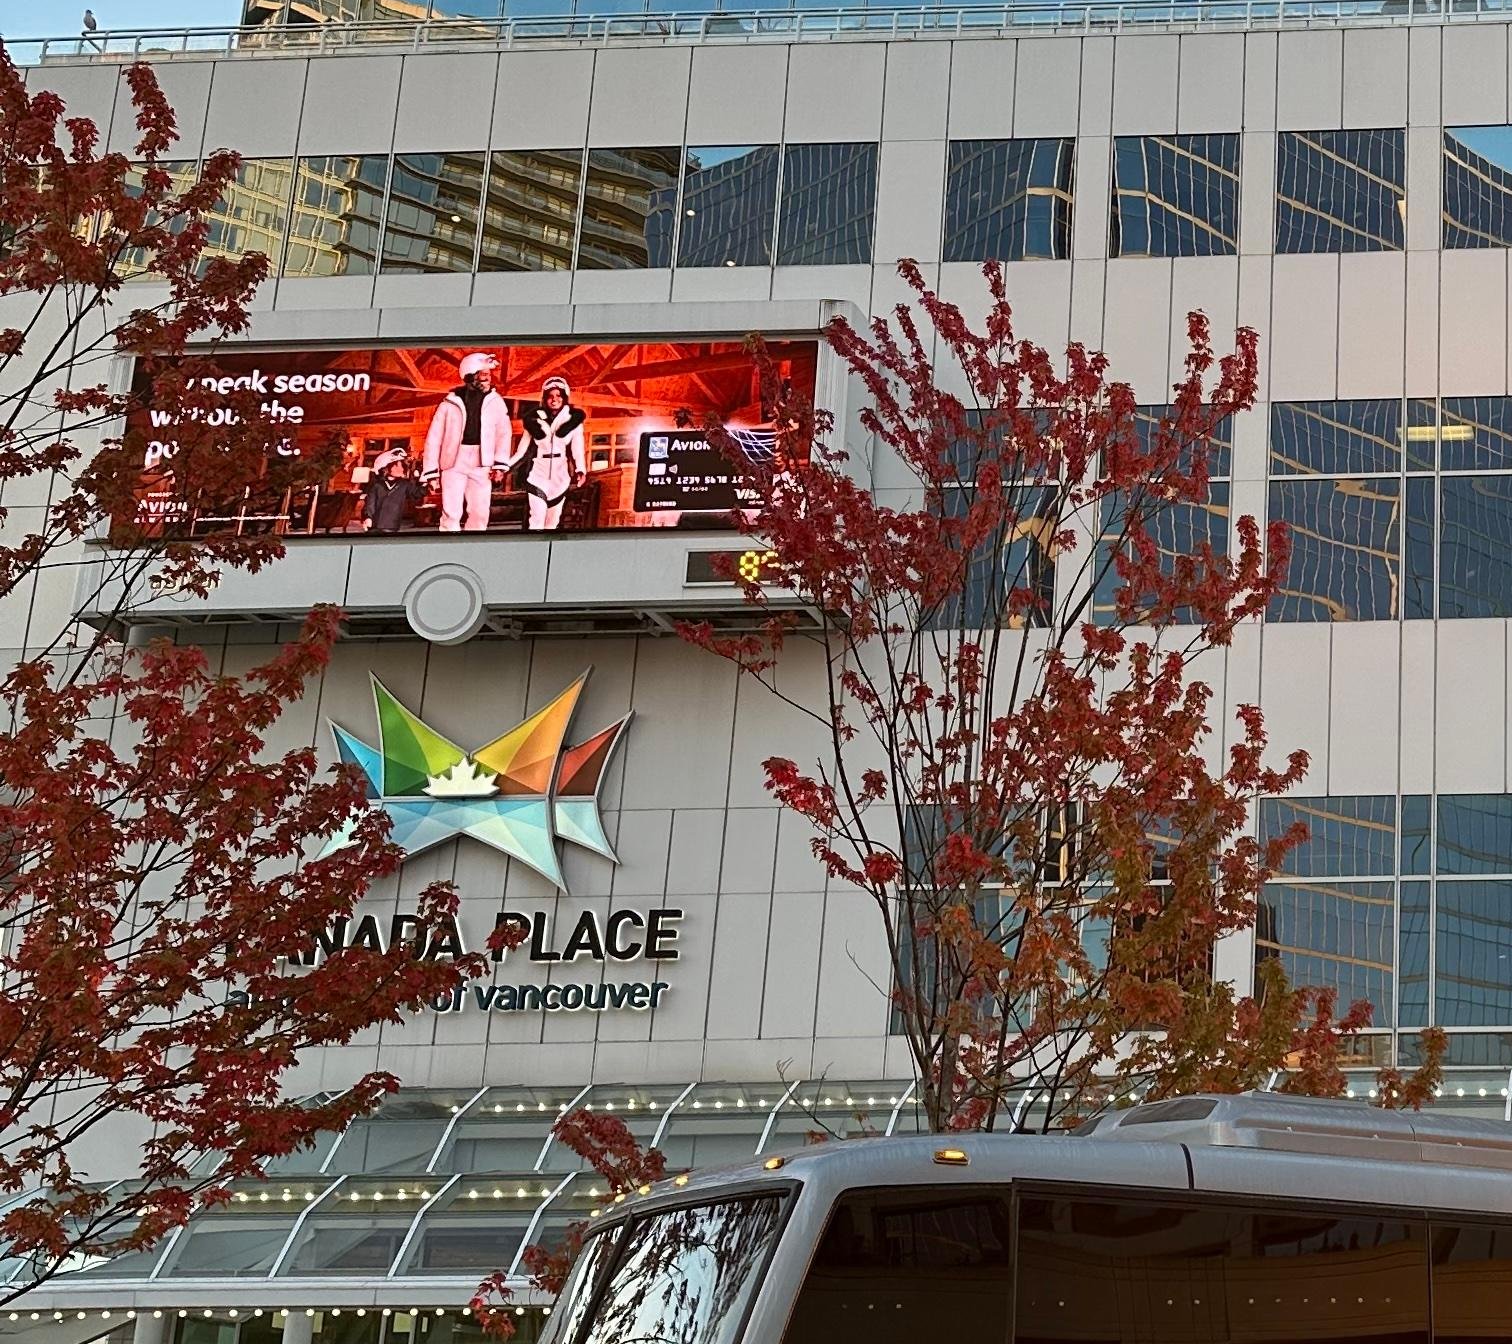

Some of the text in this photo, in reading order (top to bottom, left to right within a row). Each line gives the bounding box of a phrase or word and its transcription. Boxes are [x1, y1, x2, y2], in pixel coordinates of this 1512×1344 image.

[273, 373, 370, 394] season
[224, 909, 683, 966] NADA PLACE
[430, 976, 468, 1013] of
[475, 981, 669, 1011] vancouver
